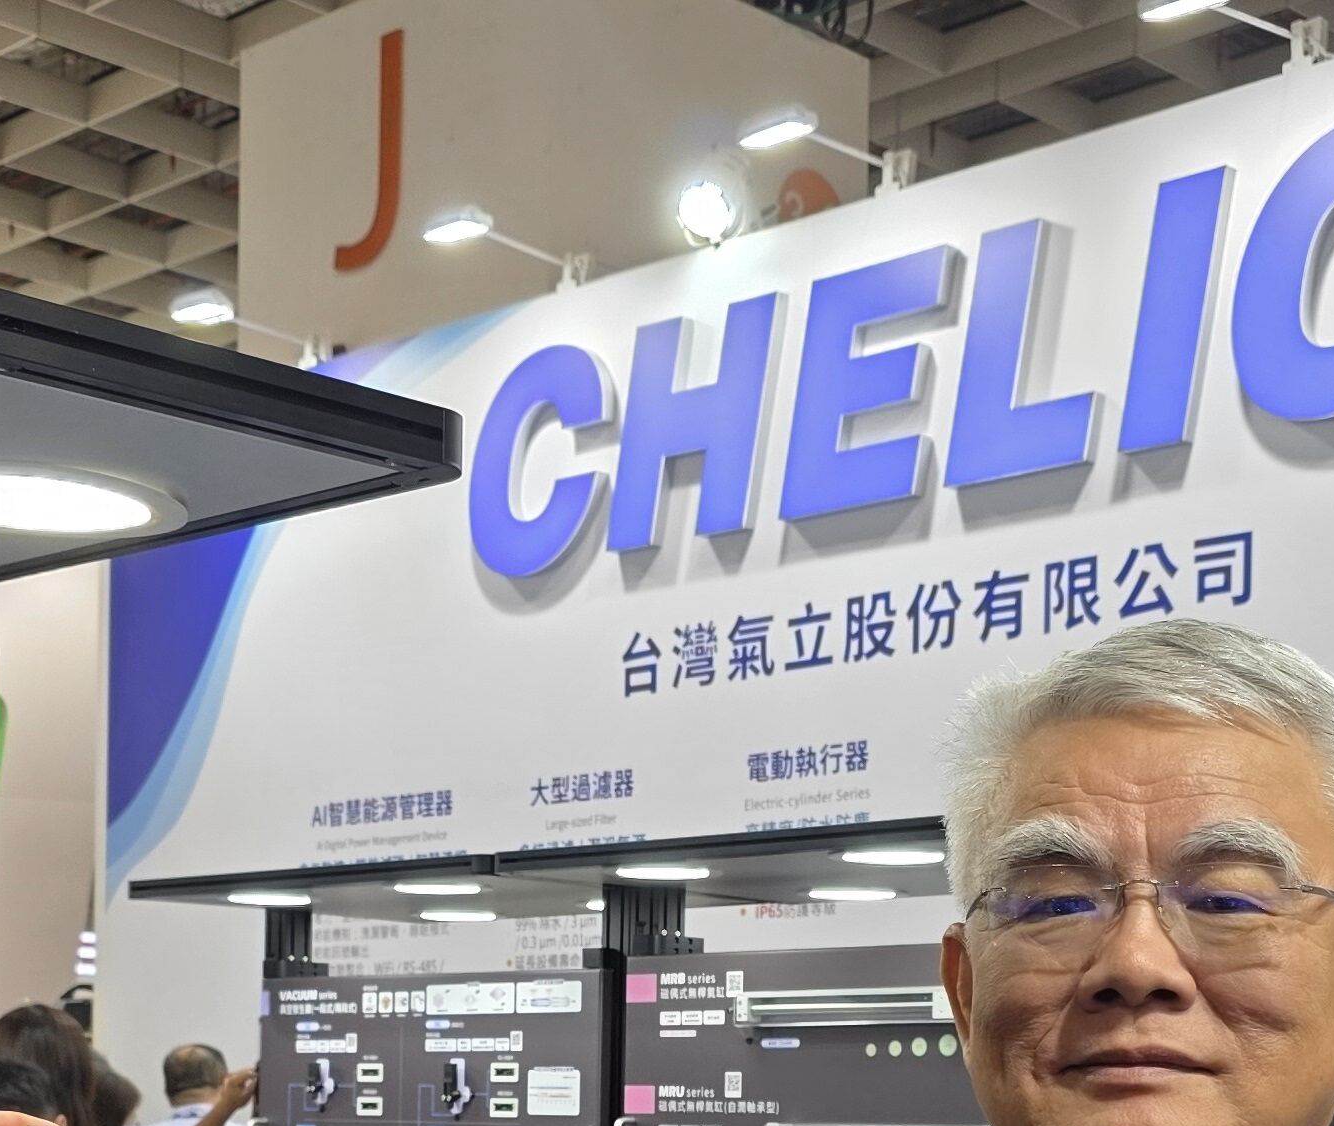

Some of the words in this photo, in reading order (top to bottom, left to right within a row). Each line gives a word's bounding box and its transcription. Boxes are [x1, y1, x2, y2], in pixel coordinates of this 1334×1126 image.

[333, 28, 405, 273] J
[620, 529, 1255, 698] 台灣氣立股份有限公司
[747, 740, 869, 783] 電動執行器
[530, 769, 634, 806] 大型過濾器
[744, 791, 833, 812] Electric-cylinder
[835, 787, 871, 801] Series
[311, 789, 454, 828] AI智慧能源管理器
[687, 973, 716, 985] series
[658, 1085, 685, 1098] MRU
[686, 1086, 715, 1098] series
